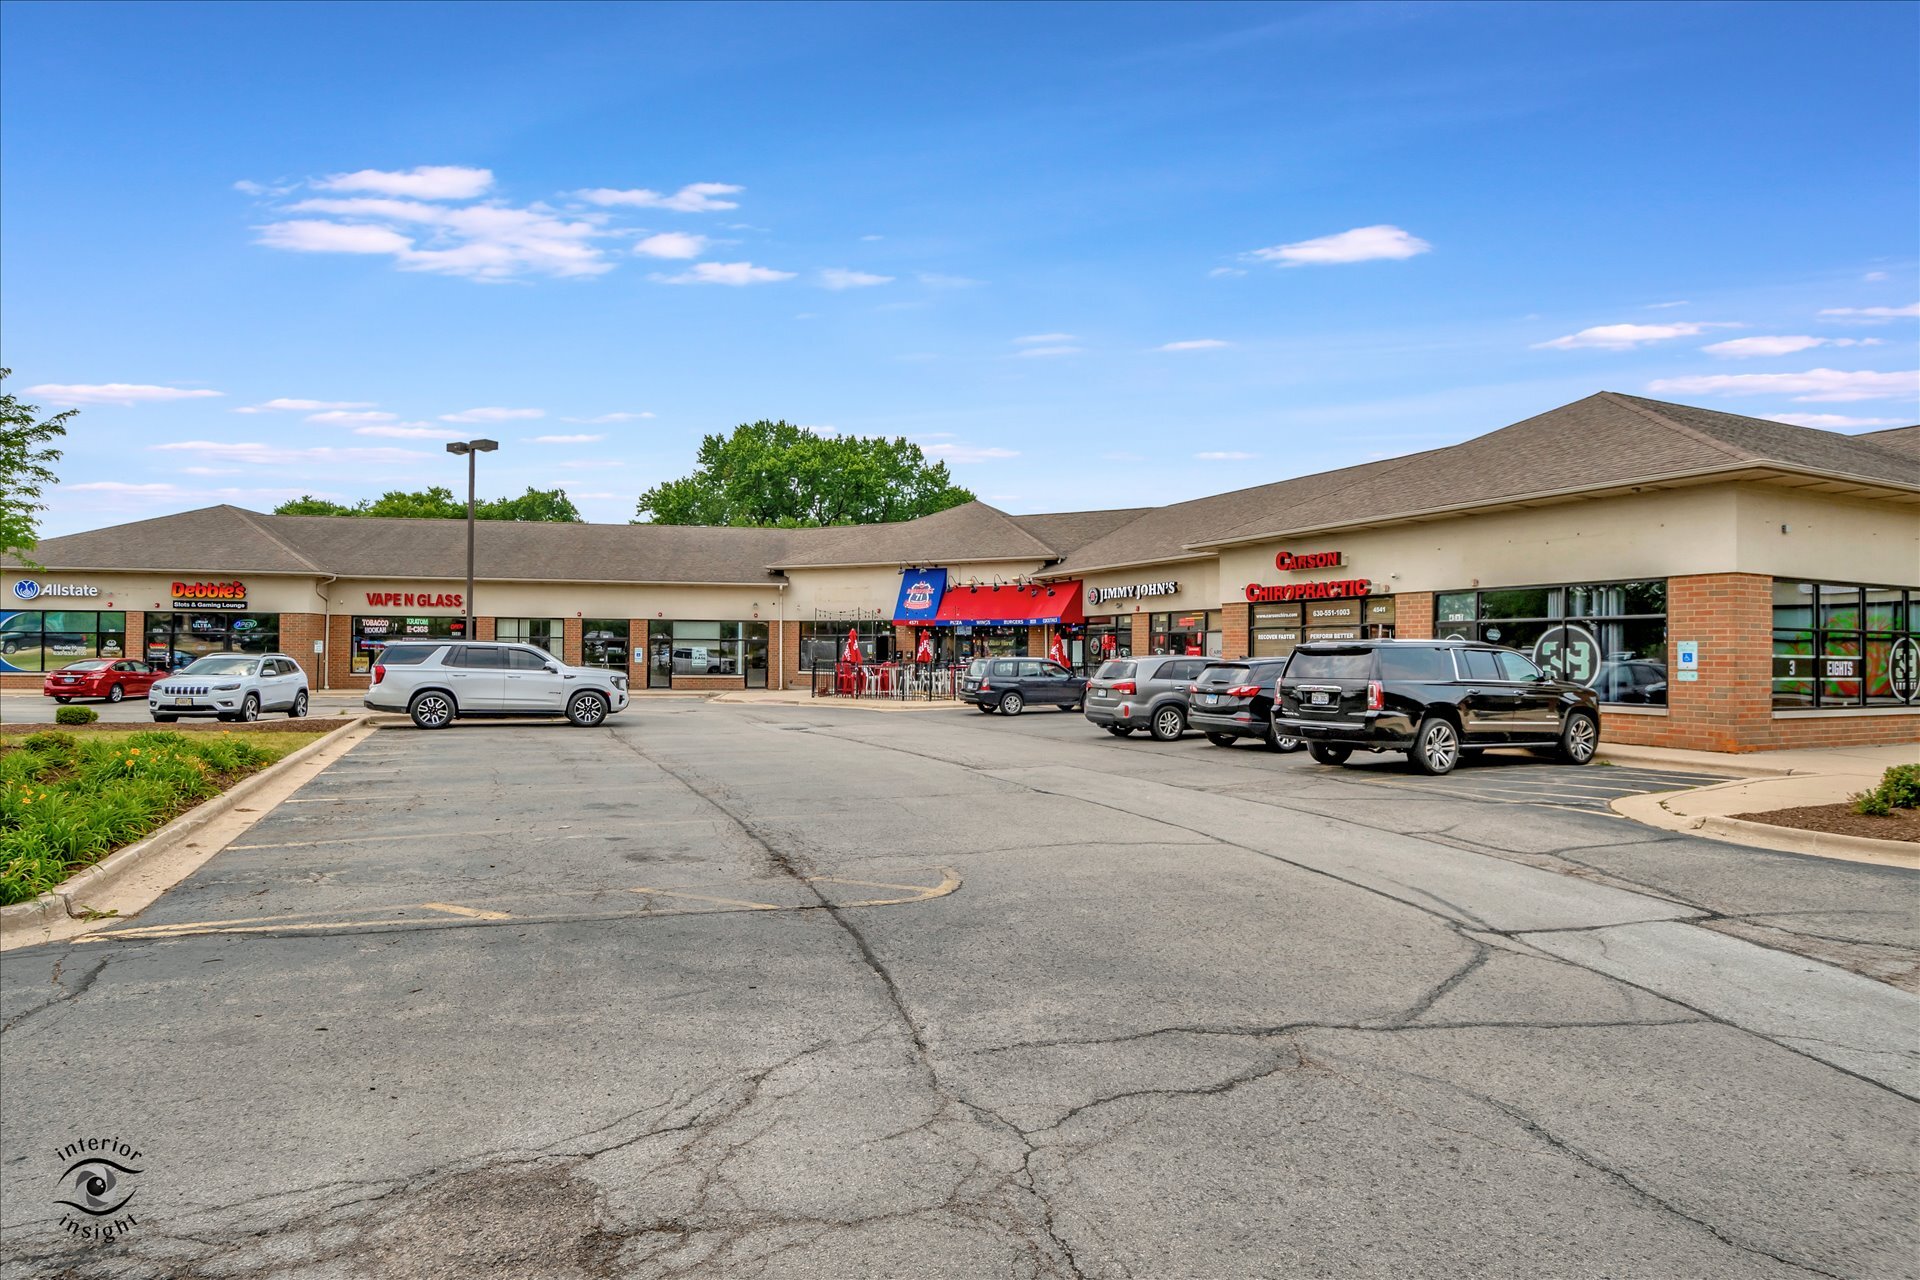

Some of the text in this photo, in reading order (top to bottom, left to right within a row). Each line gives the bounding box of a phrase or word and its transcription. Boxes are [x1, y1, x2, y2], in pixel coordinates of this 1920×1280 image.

[1276, 551, 1338, 571] CARSON
[40, 583, 98, 597] Allstate
[171, 581, 247, 599] Debbie's
[915, 593, 923, 601] 71
[1099, 581, 1177, 603] JIMMY JOHN'S
[1245, 579, 1368, 602] CHIROPRACTIC
[366, 592, 463, 607] VAPE N GLASS
[362, 619, 389, 627] TOBACCO
[1788, 660, 1796, 676] 3
[1826, 660, 1854, 677] EIGHTS
